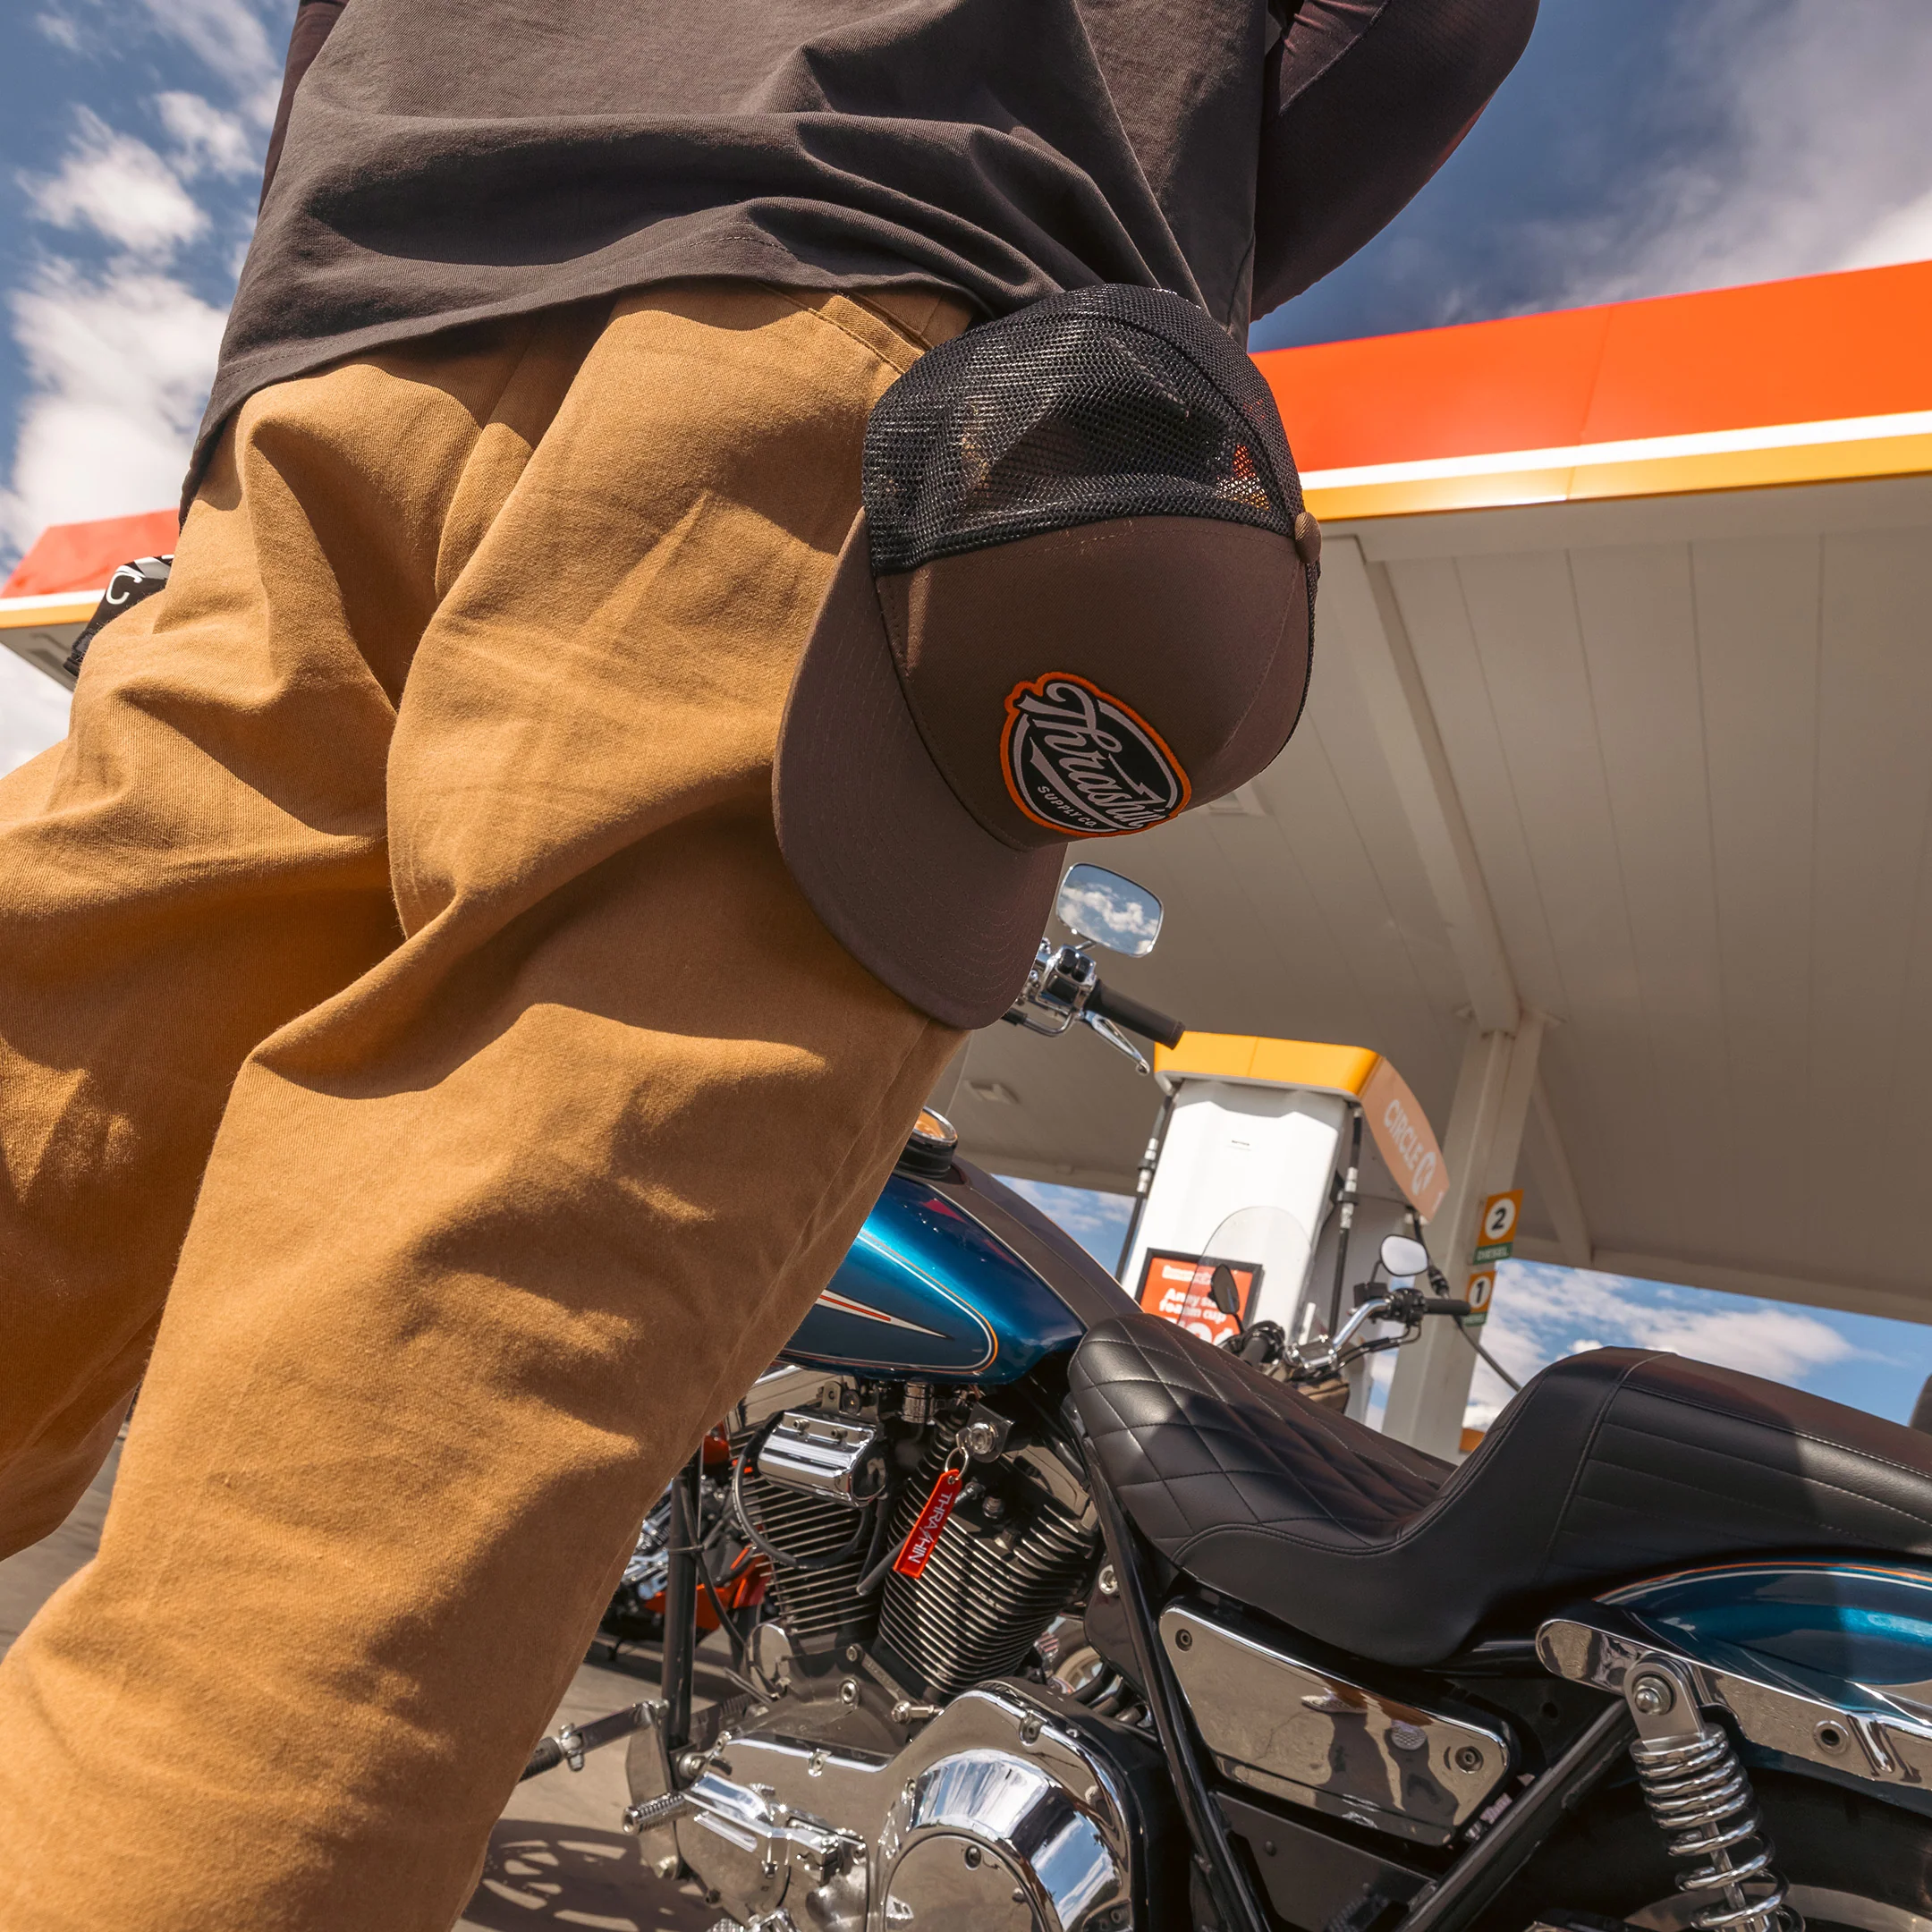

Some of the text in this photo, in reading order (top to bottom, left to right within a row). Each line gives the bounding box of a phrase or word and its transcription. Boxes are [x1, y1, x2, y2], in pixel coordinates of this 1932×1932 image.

[1017, 682, 1166, 829] Thrashin
[1038, 785, 1097, 827] SUPPLY CO.
[1384, 1099, 1424, 1170] CIRCLE
[1491, 1207, 1507, 1231] 2
[1476, 1280, 1485, 1303] 1
